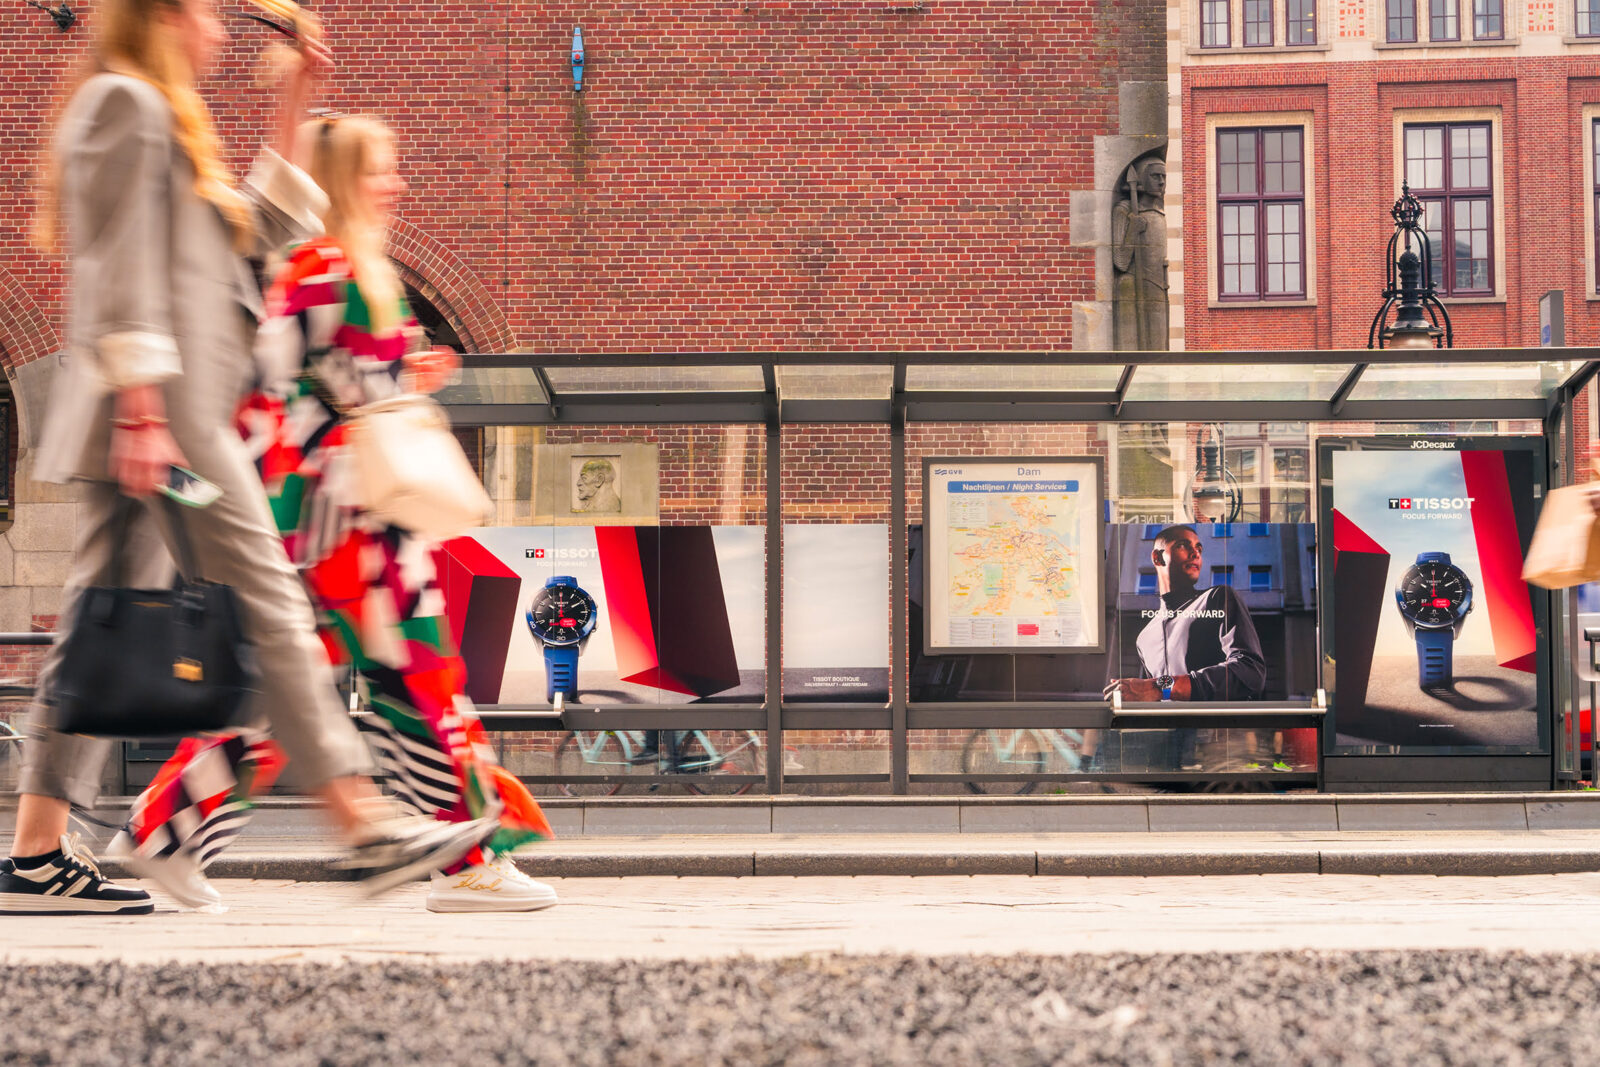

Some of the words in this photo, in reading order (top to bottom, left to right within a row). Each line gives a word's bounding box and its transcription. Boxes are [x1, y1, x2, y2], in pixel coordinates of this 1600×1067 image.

[1410, 440, 1455, 448] JCDecaux
[1018, 468, 1041, 476] Dam
[962, 483, 1005, 492] Nachtlijnen
[1012, 483, 1033, 492] Night
[1413, 498, 1475, 509] TISSOT
[546, 549, 598, 558] TISSOT
[1141, 610, 1174, 618] FOCUS
[1176, 610, 1225, 618] FORWARD
